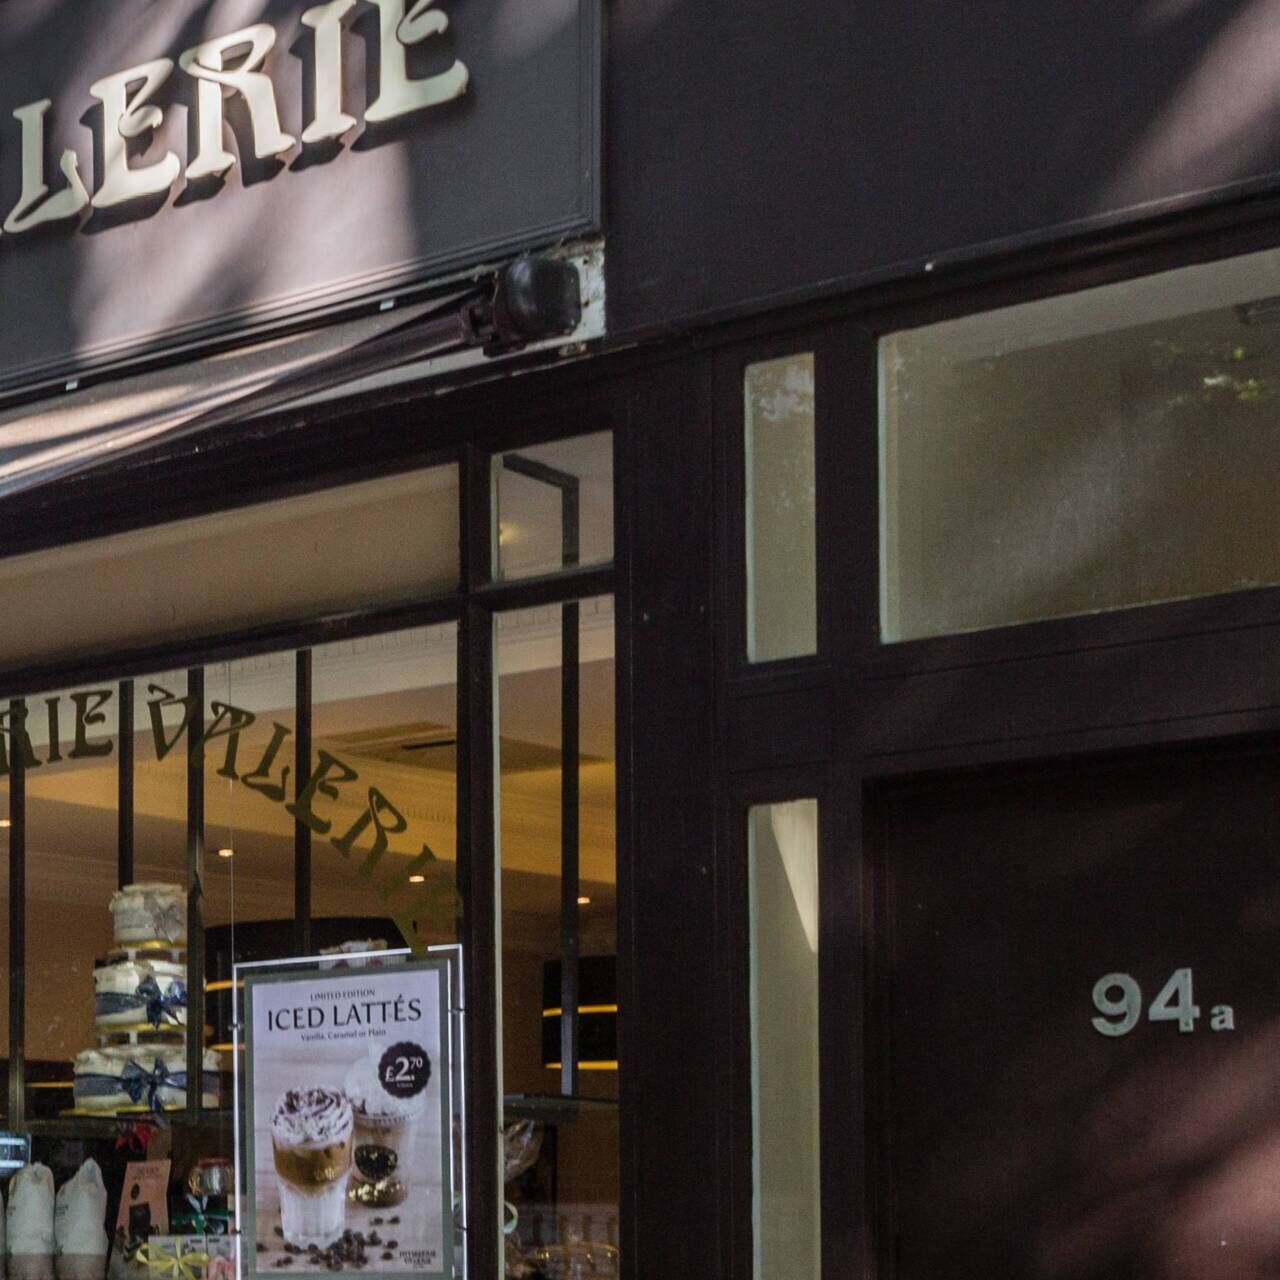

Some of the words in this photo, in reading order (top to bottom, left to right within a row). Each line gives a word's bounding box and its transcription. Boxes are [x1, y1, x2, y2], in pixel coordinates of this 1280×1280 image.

[309, 991, 343, 1002] LIMITED
[344, 989, 376, 999] EDITION
[268, 1004, 325, 1032] ICED
[333, 993, 422, 1026] LATTÉS
[328, 1029, 357, 1041] Caramel
[368, 1027, 386, 1037] Plain
